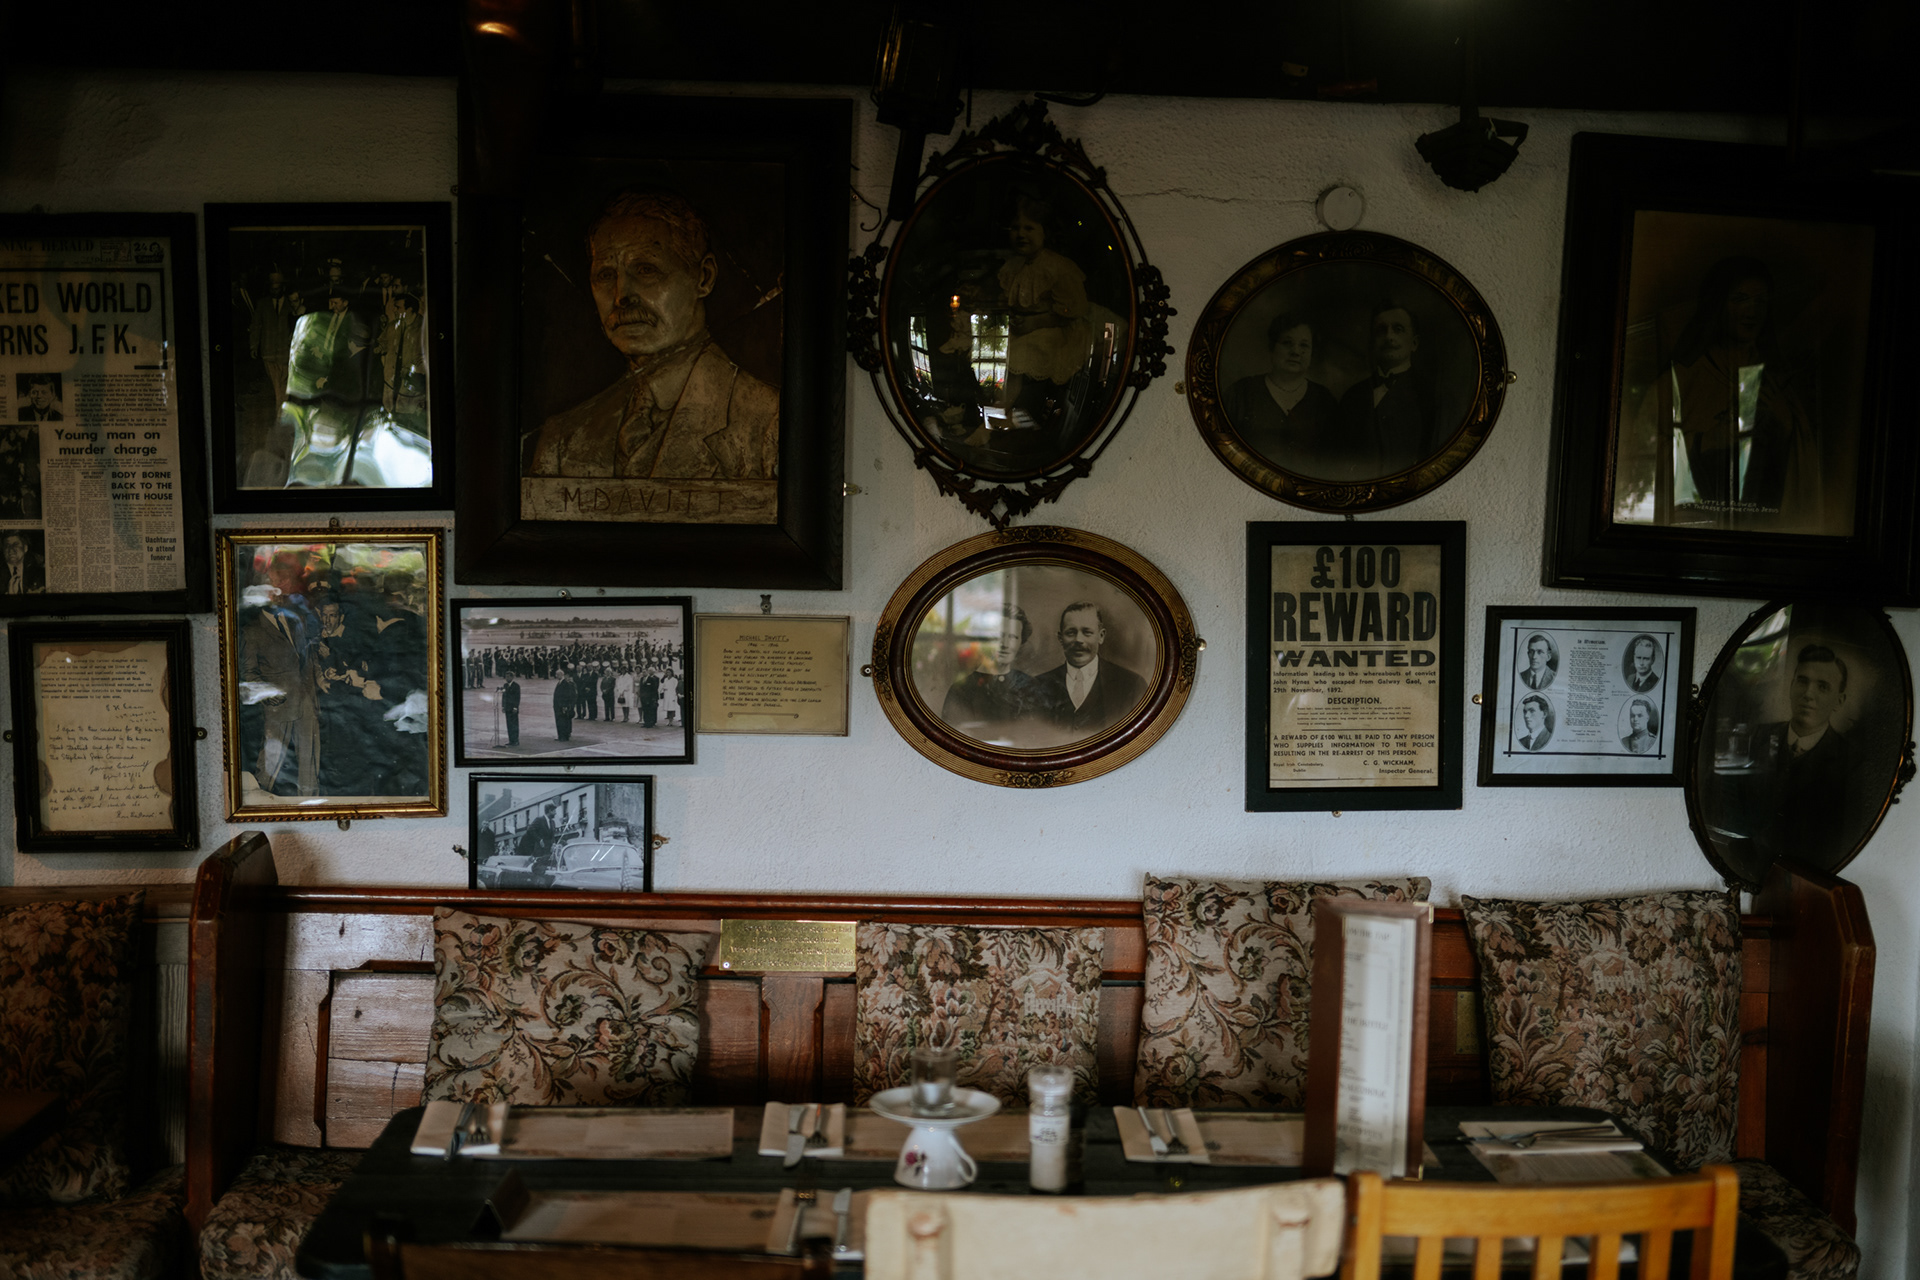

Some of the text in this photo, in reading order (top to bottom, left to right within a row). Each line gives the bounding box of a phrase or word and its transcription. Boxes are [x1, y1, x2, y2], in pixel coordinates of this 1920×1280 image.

[41, 239, 94, 251] HERALD
[0, 282, 152, 314] ED WORLD
[55, 429, 160, 442] Young man on
[59, 444, 157, 457] murder charge
[112, 471, 136, 479] BODY
[142, 471, 171, 479] BORNE
[112, 482, 136, 490] BACK
[1310, 546, 1400, 589] £100
[1273, 592, 1437, 642] REWARD
[1274, 650, 1436, 667] WANTED
[1327, 697, 1382, 705] DESCRIPTION.
